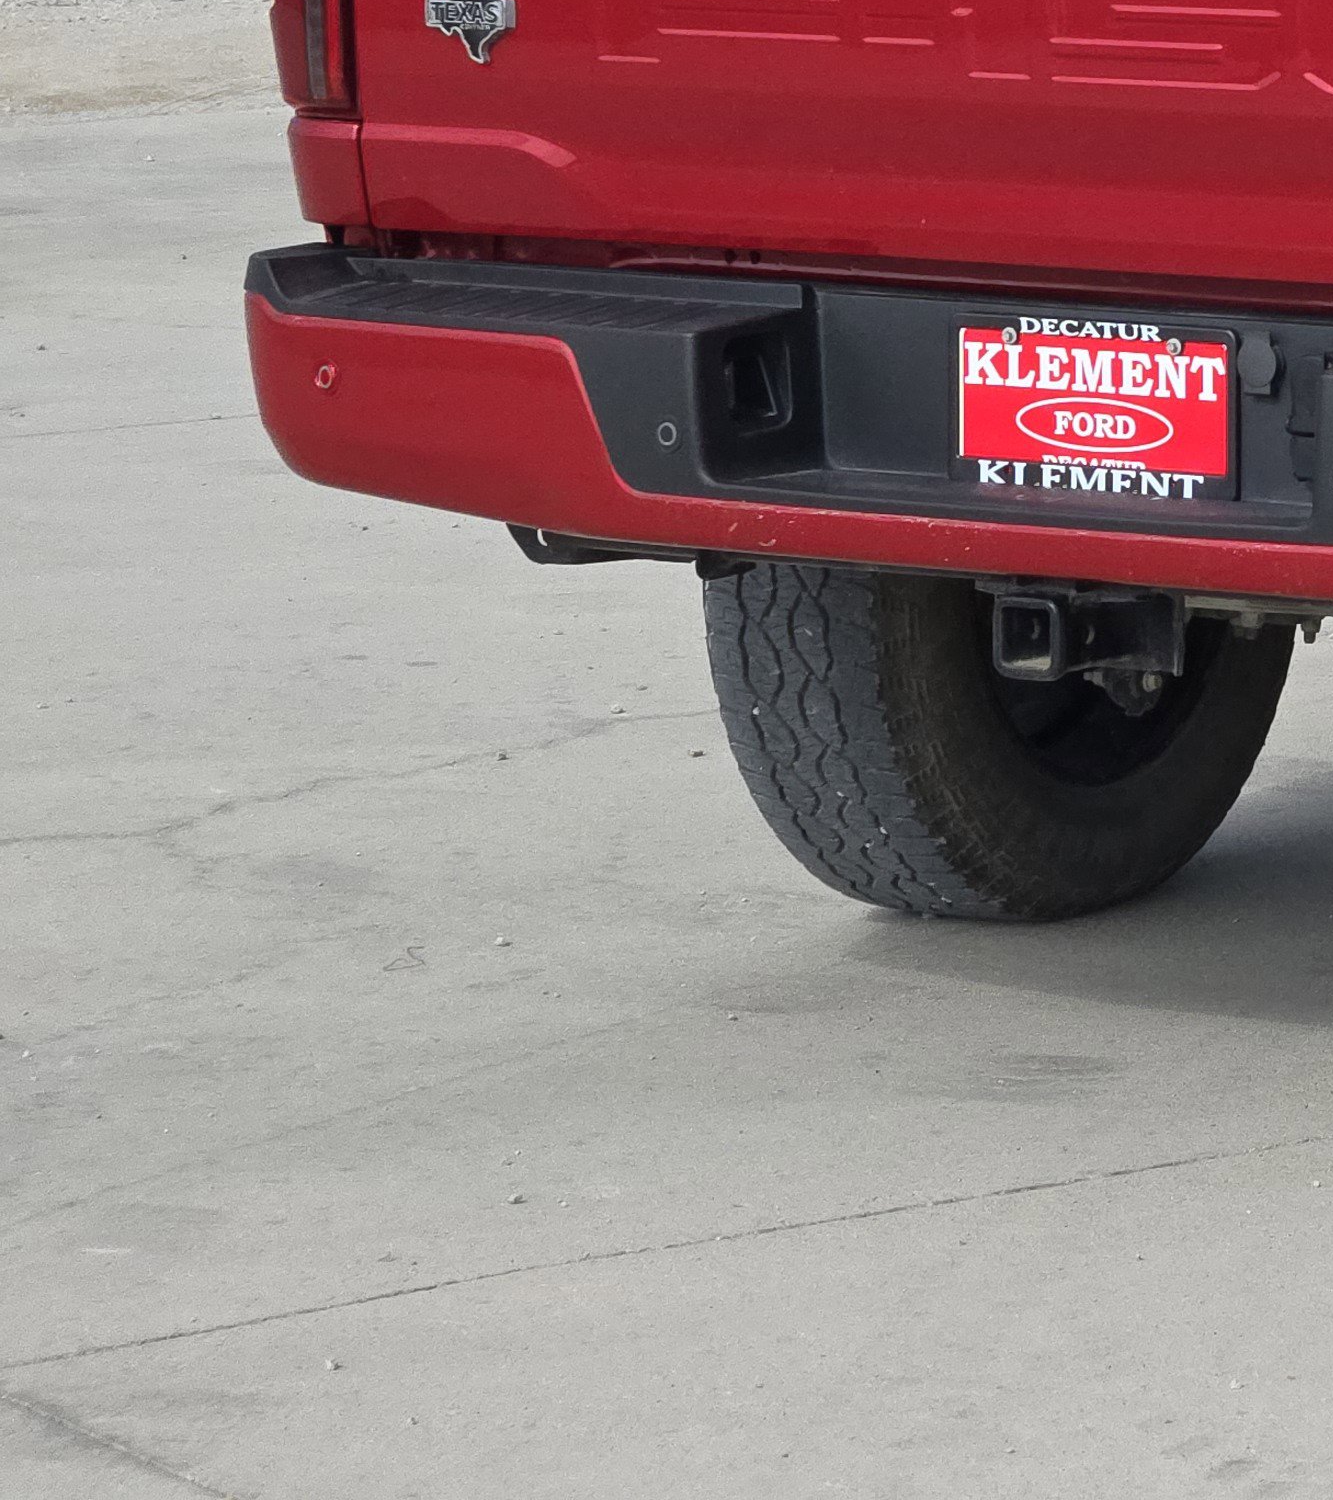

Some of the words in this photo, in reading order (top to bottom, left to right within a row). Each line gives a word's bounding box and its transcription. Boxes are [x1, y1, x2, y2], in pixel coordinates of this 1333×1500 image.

[430, 1, 499, 24] TEXAS
[1019, 316, 1163, 342] DECATUR
[964, 340, 1227, 402] KLEMENT
[1054, 410, 1137, 440] FORD
